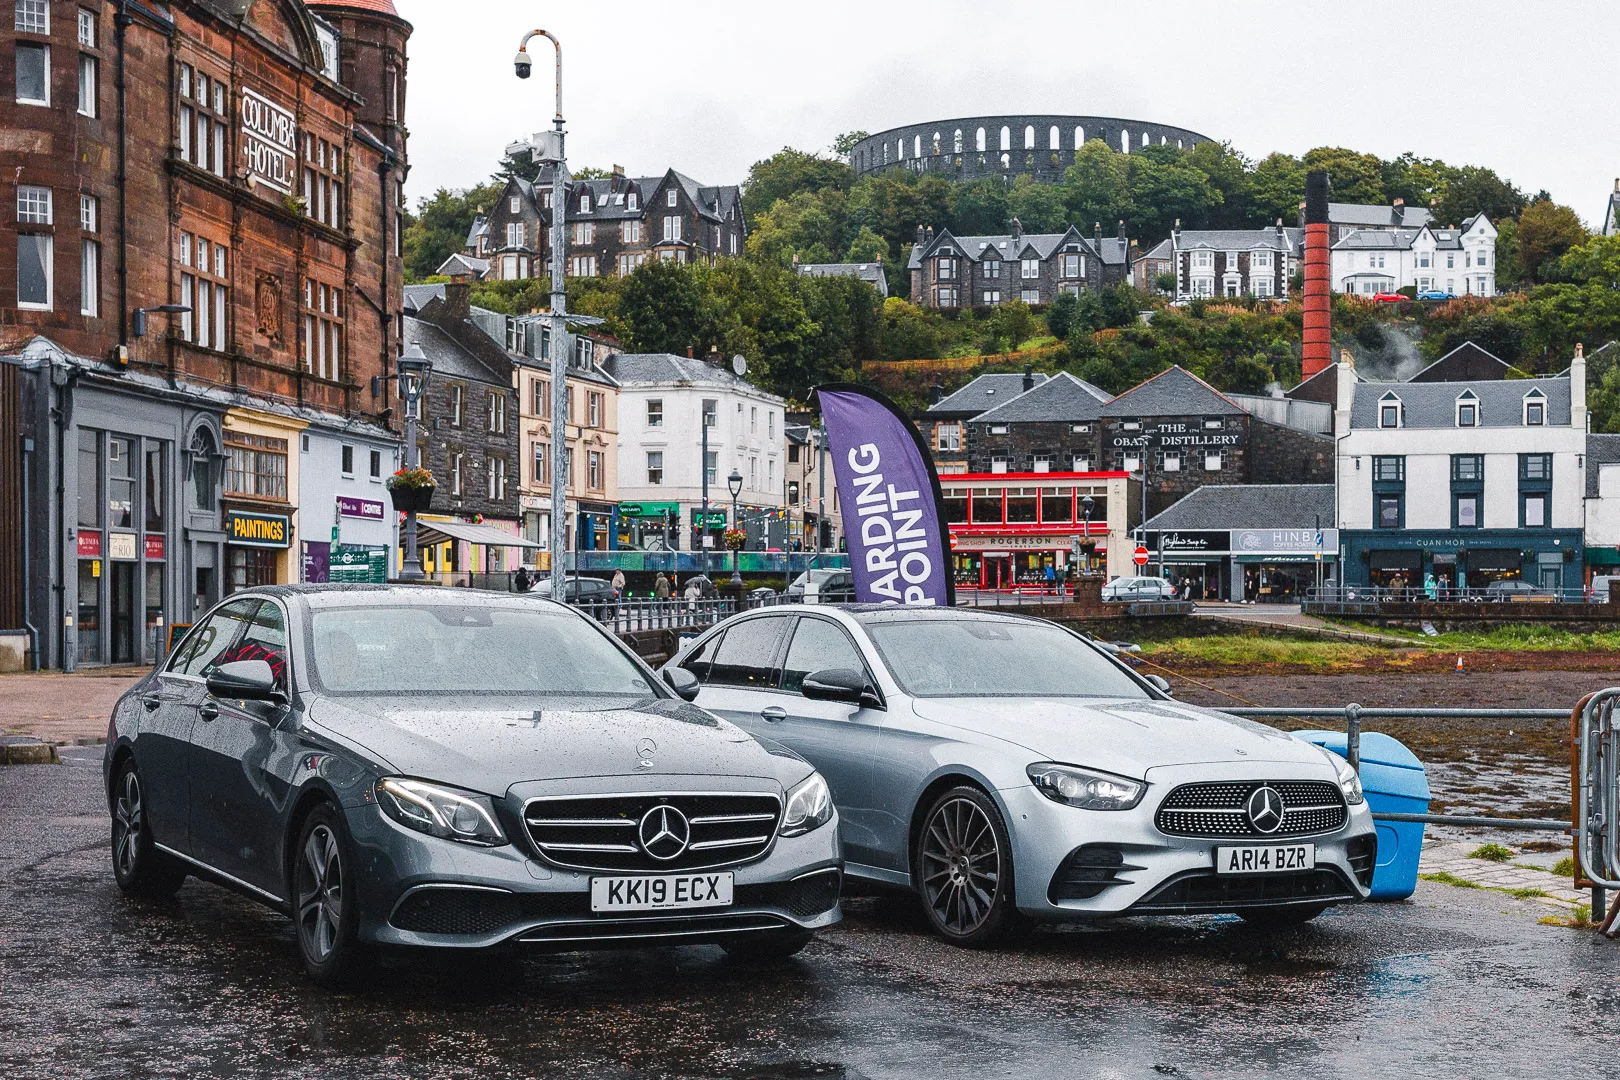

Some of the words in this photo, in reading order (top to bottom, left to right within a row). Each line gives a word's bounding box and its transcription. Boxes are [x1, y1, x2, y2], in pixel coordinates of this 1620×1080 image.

[242, 96, 296, 151] COLUMBA
[248, 138, 292, 187] HOTEL
[1158, 424, 1187, 433] THE
[1113, 437, 1149, 447] OBAN
[1161, 435, 1239, 446] DISTILLERY
[620, 505, 641, 513] Specsavers
[234, 518, 283, 541] PAINTINGS
[848, 442, 902, 605] ARDING
[118, 544, 132, 557] RIO
[887, 484, 936, 606] POINT
[991, 537, 1051, 545] ROGERSON
[1229, 849, 1270, 871] AR14
[1275, 847, 1306, 868] BZR
[608, 879, 666, 904] KK19
[675, 876, 719, 902] ECX
